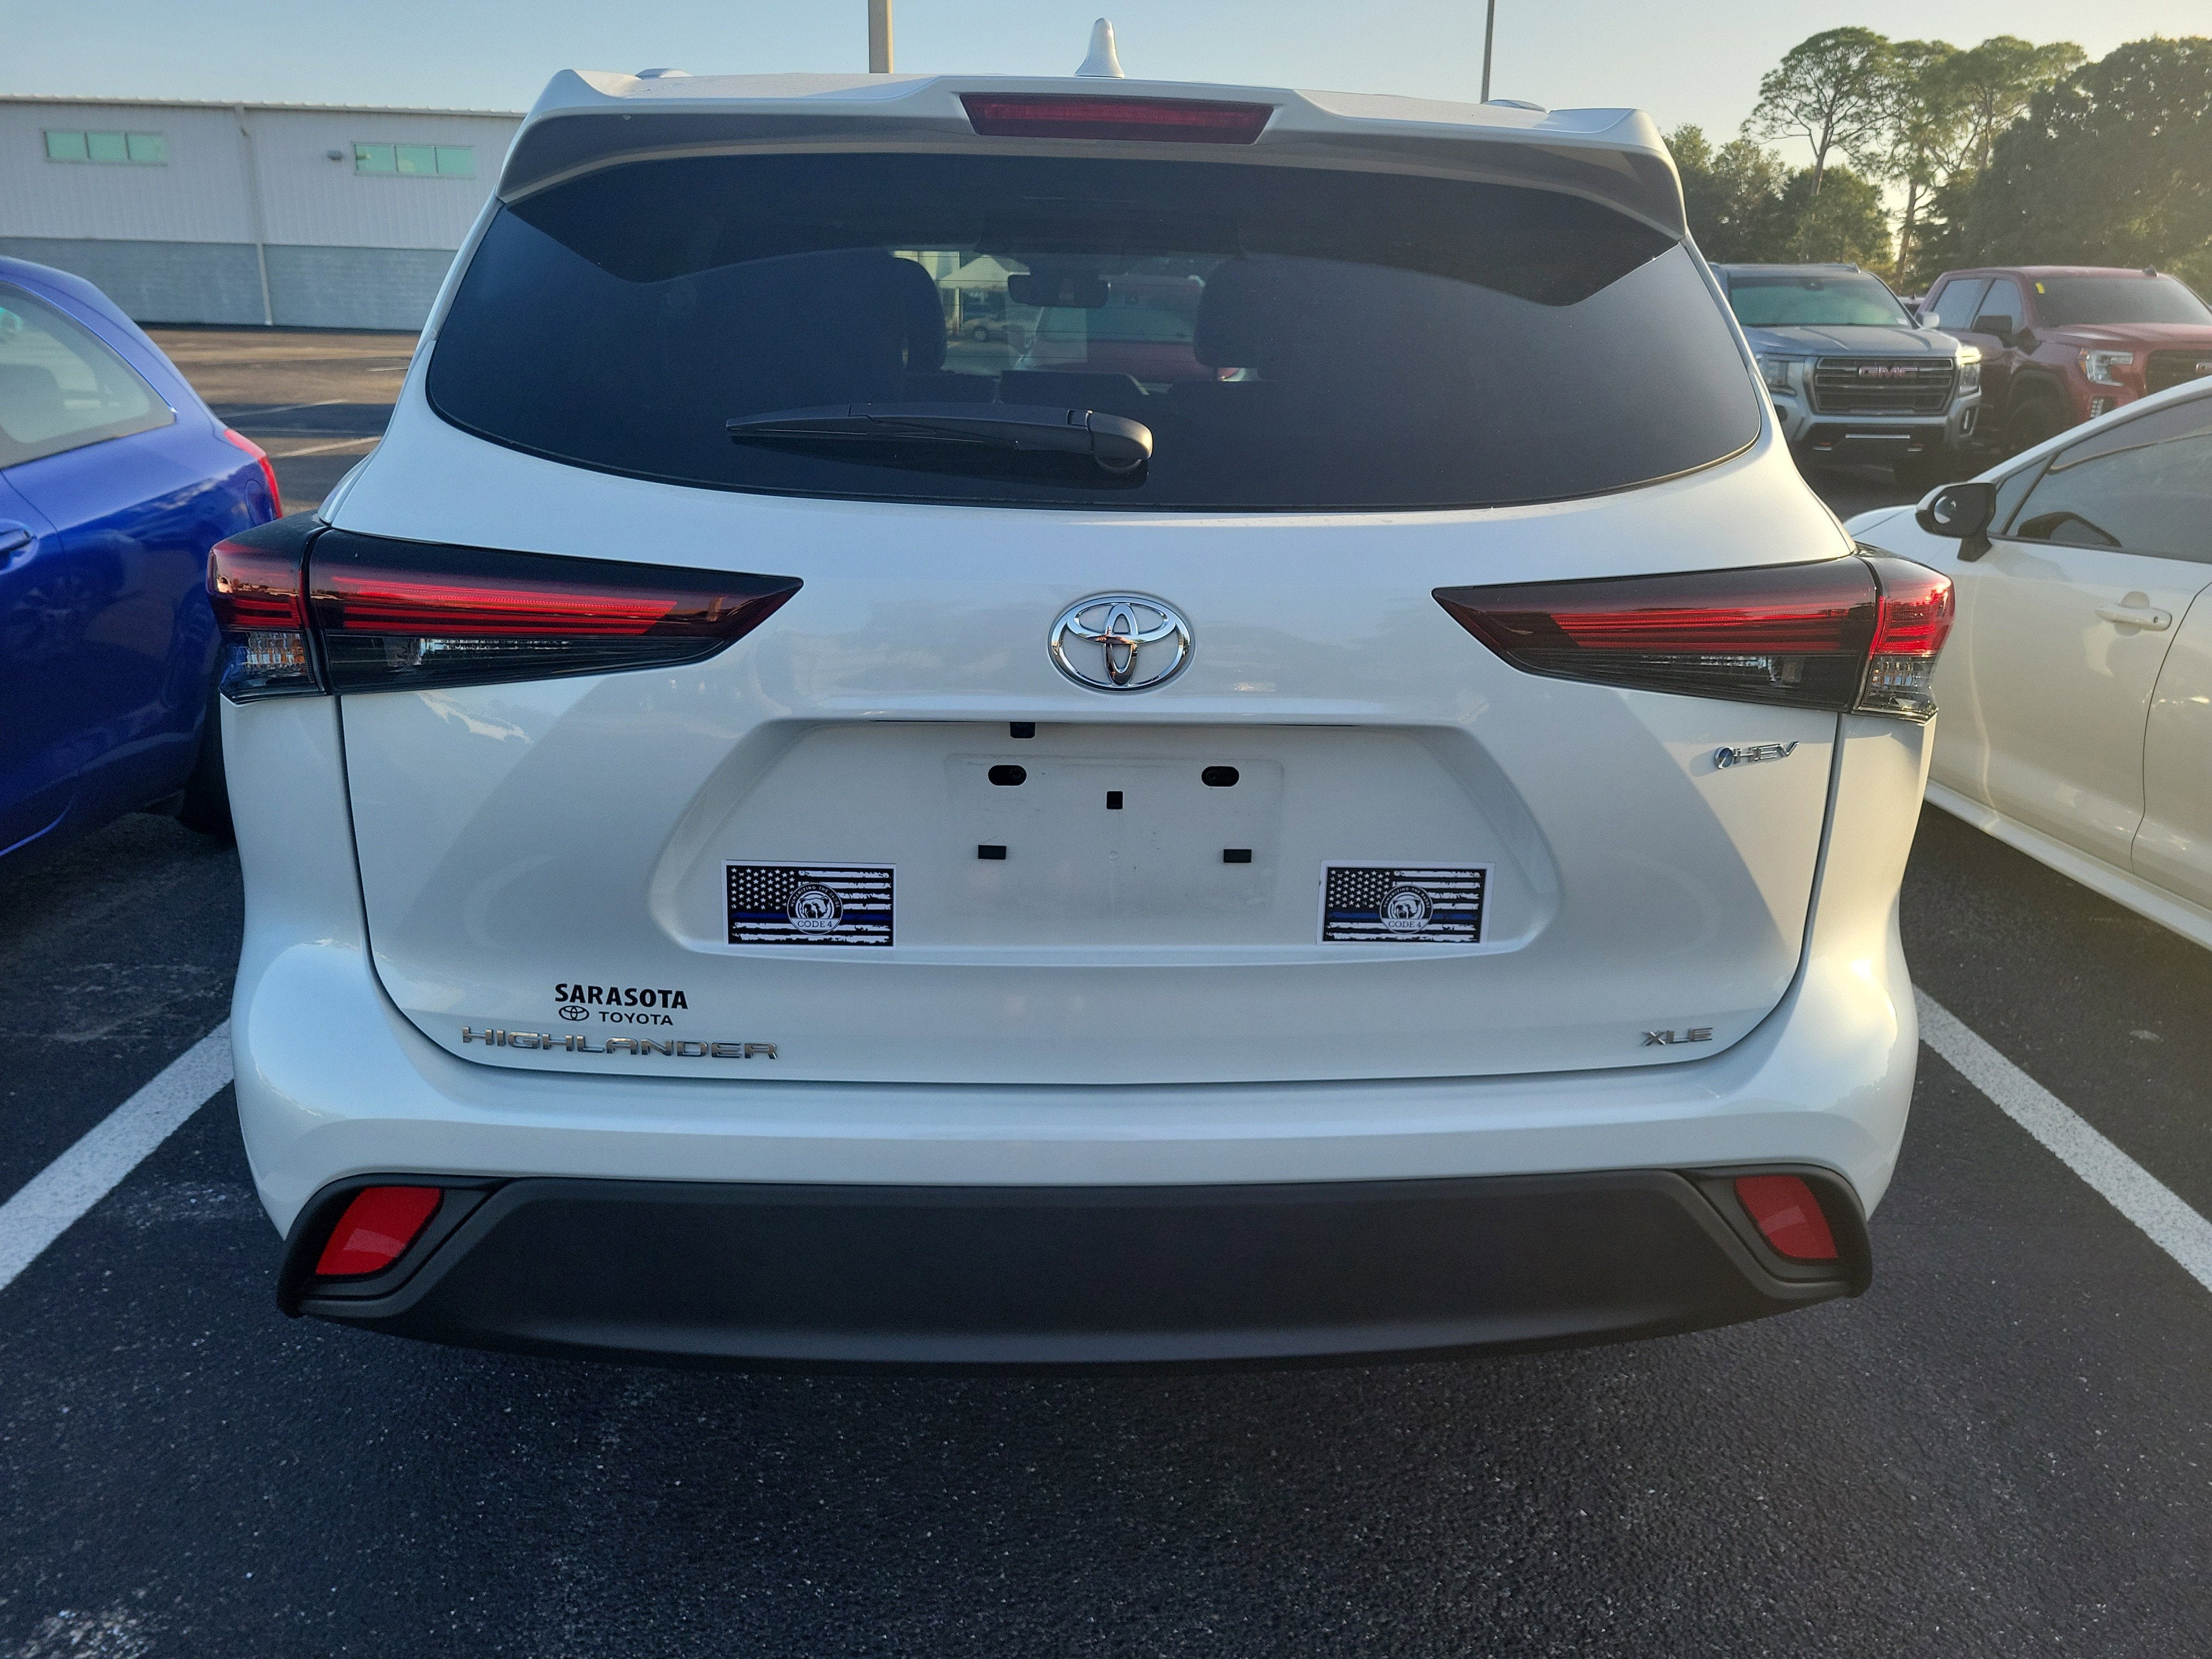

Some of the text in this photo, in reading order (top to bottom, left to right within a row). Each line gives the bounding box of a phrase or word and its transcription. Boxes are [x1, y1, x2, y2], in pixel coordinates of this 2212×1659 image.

[1858, 365, 1919, 378] GMC
[555, 983, 688, 1009] SARASOTA
[599, 1011, 674, 1025] TOYOTA
[462, 1026, 778, 1059] HIGHLANDER
[1640, 1026, 1713, 1046] XLE
